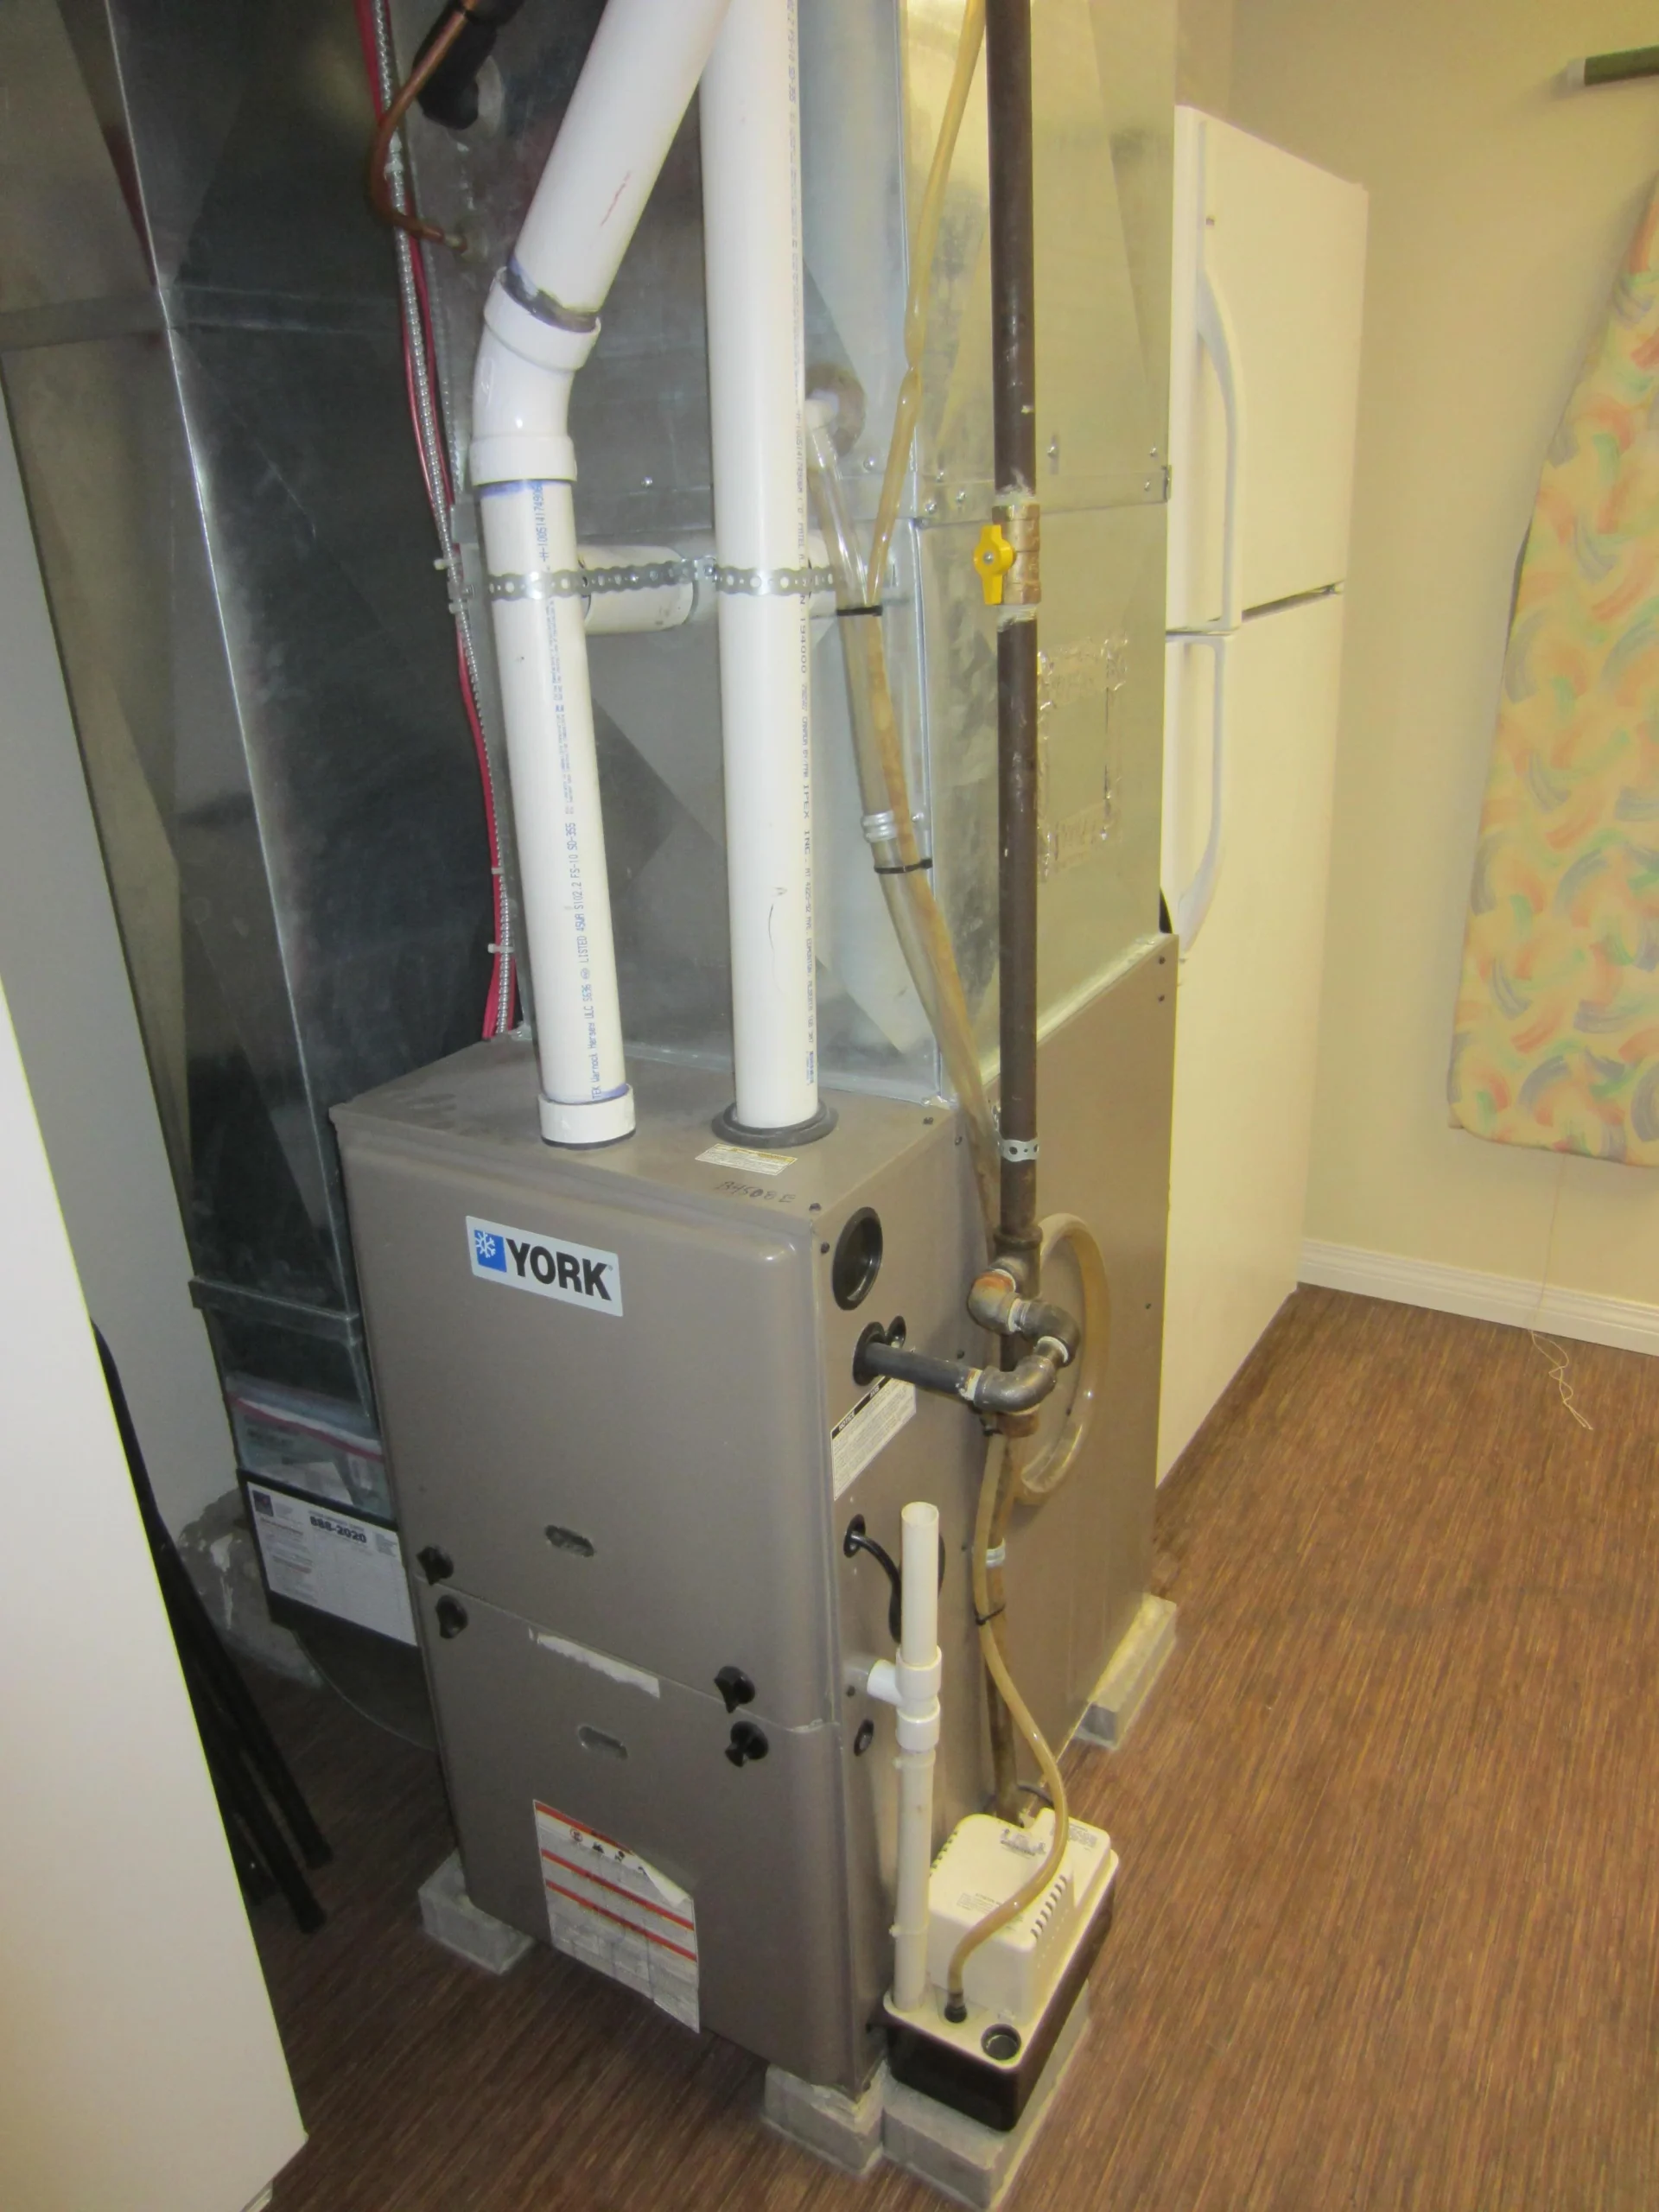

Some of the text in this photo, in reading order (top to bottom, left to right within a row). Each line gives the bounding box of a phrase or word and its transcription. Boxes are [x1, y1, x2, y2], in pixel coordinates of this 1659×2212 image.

[565, 823, 578, 851] SD-355
[568, 854, 581, 879] FS-10
[571, 881, 584, 910] S102.2
[576, 936, 589, 963] LISTED
[587, 1022, 597, 1050] Hersey
[505, 1237, 612, 1301] YORK
